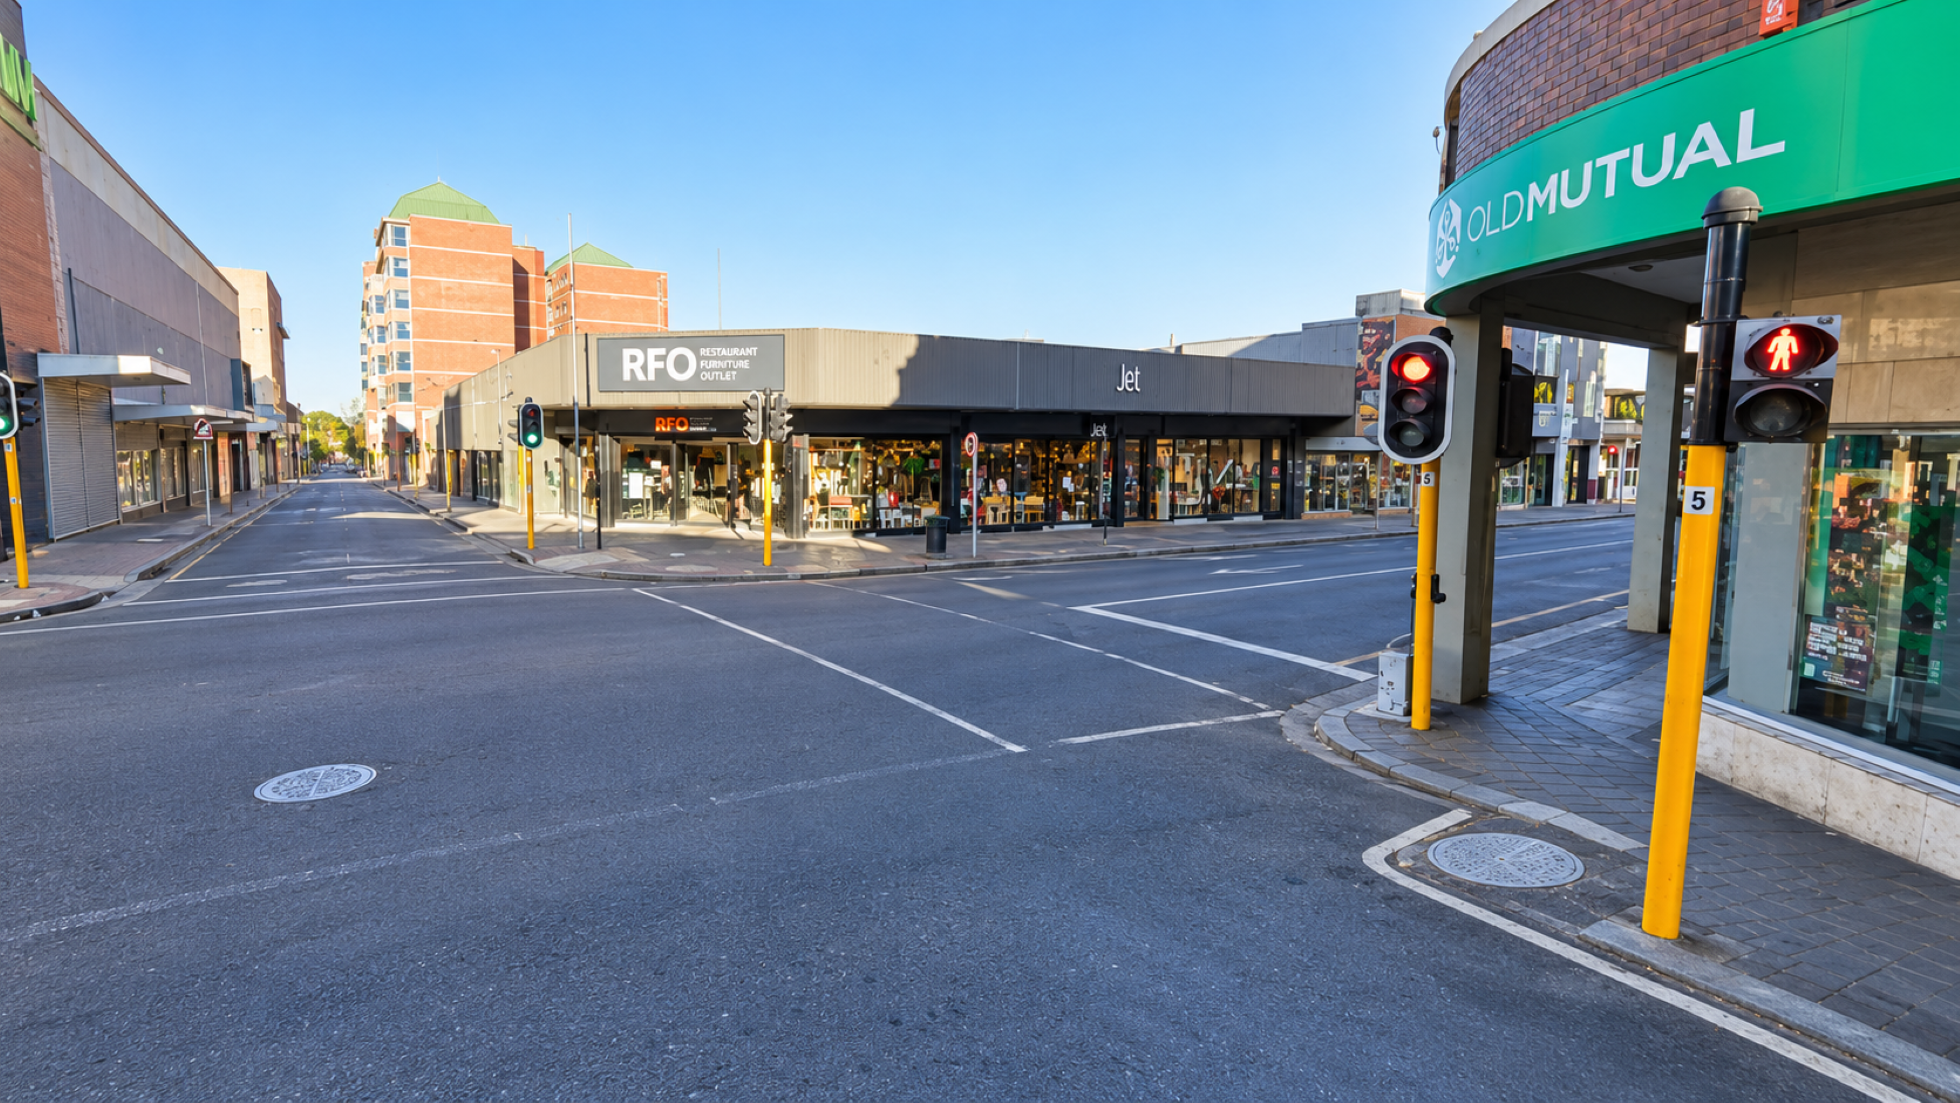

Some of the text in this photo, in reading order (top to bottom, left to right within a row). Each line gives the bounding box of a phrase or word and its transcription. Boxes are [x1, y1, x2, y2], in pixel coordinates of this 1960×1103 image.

[700, 347, 758, 357] RESTAURANT
[622, 347, 697, 381] RFO
[700, 359, 750, 369] FURNITURE
[700, 371, 737, 381] OUTLET
[1116, 363, 1141, 392] Jet
[655, 417, 689, 432] RFO
[1090, 422, 1107, 437] Jet
[1424, 473, 1431, 485] 5
[1691, 491, 1706, 511] 5
